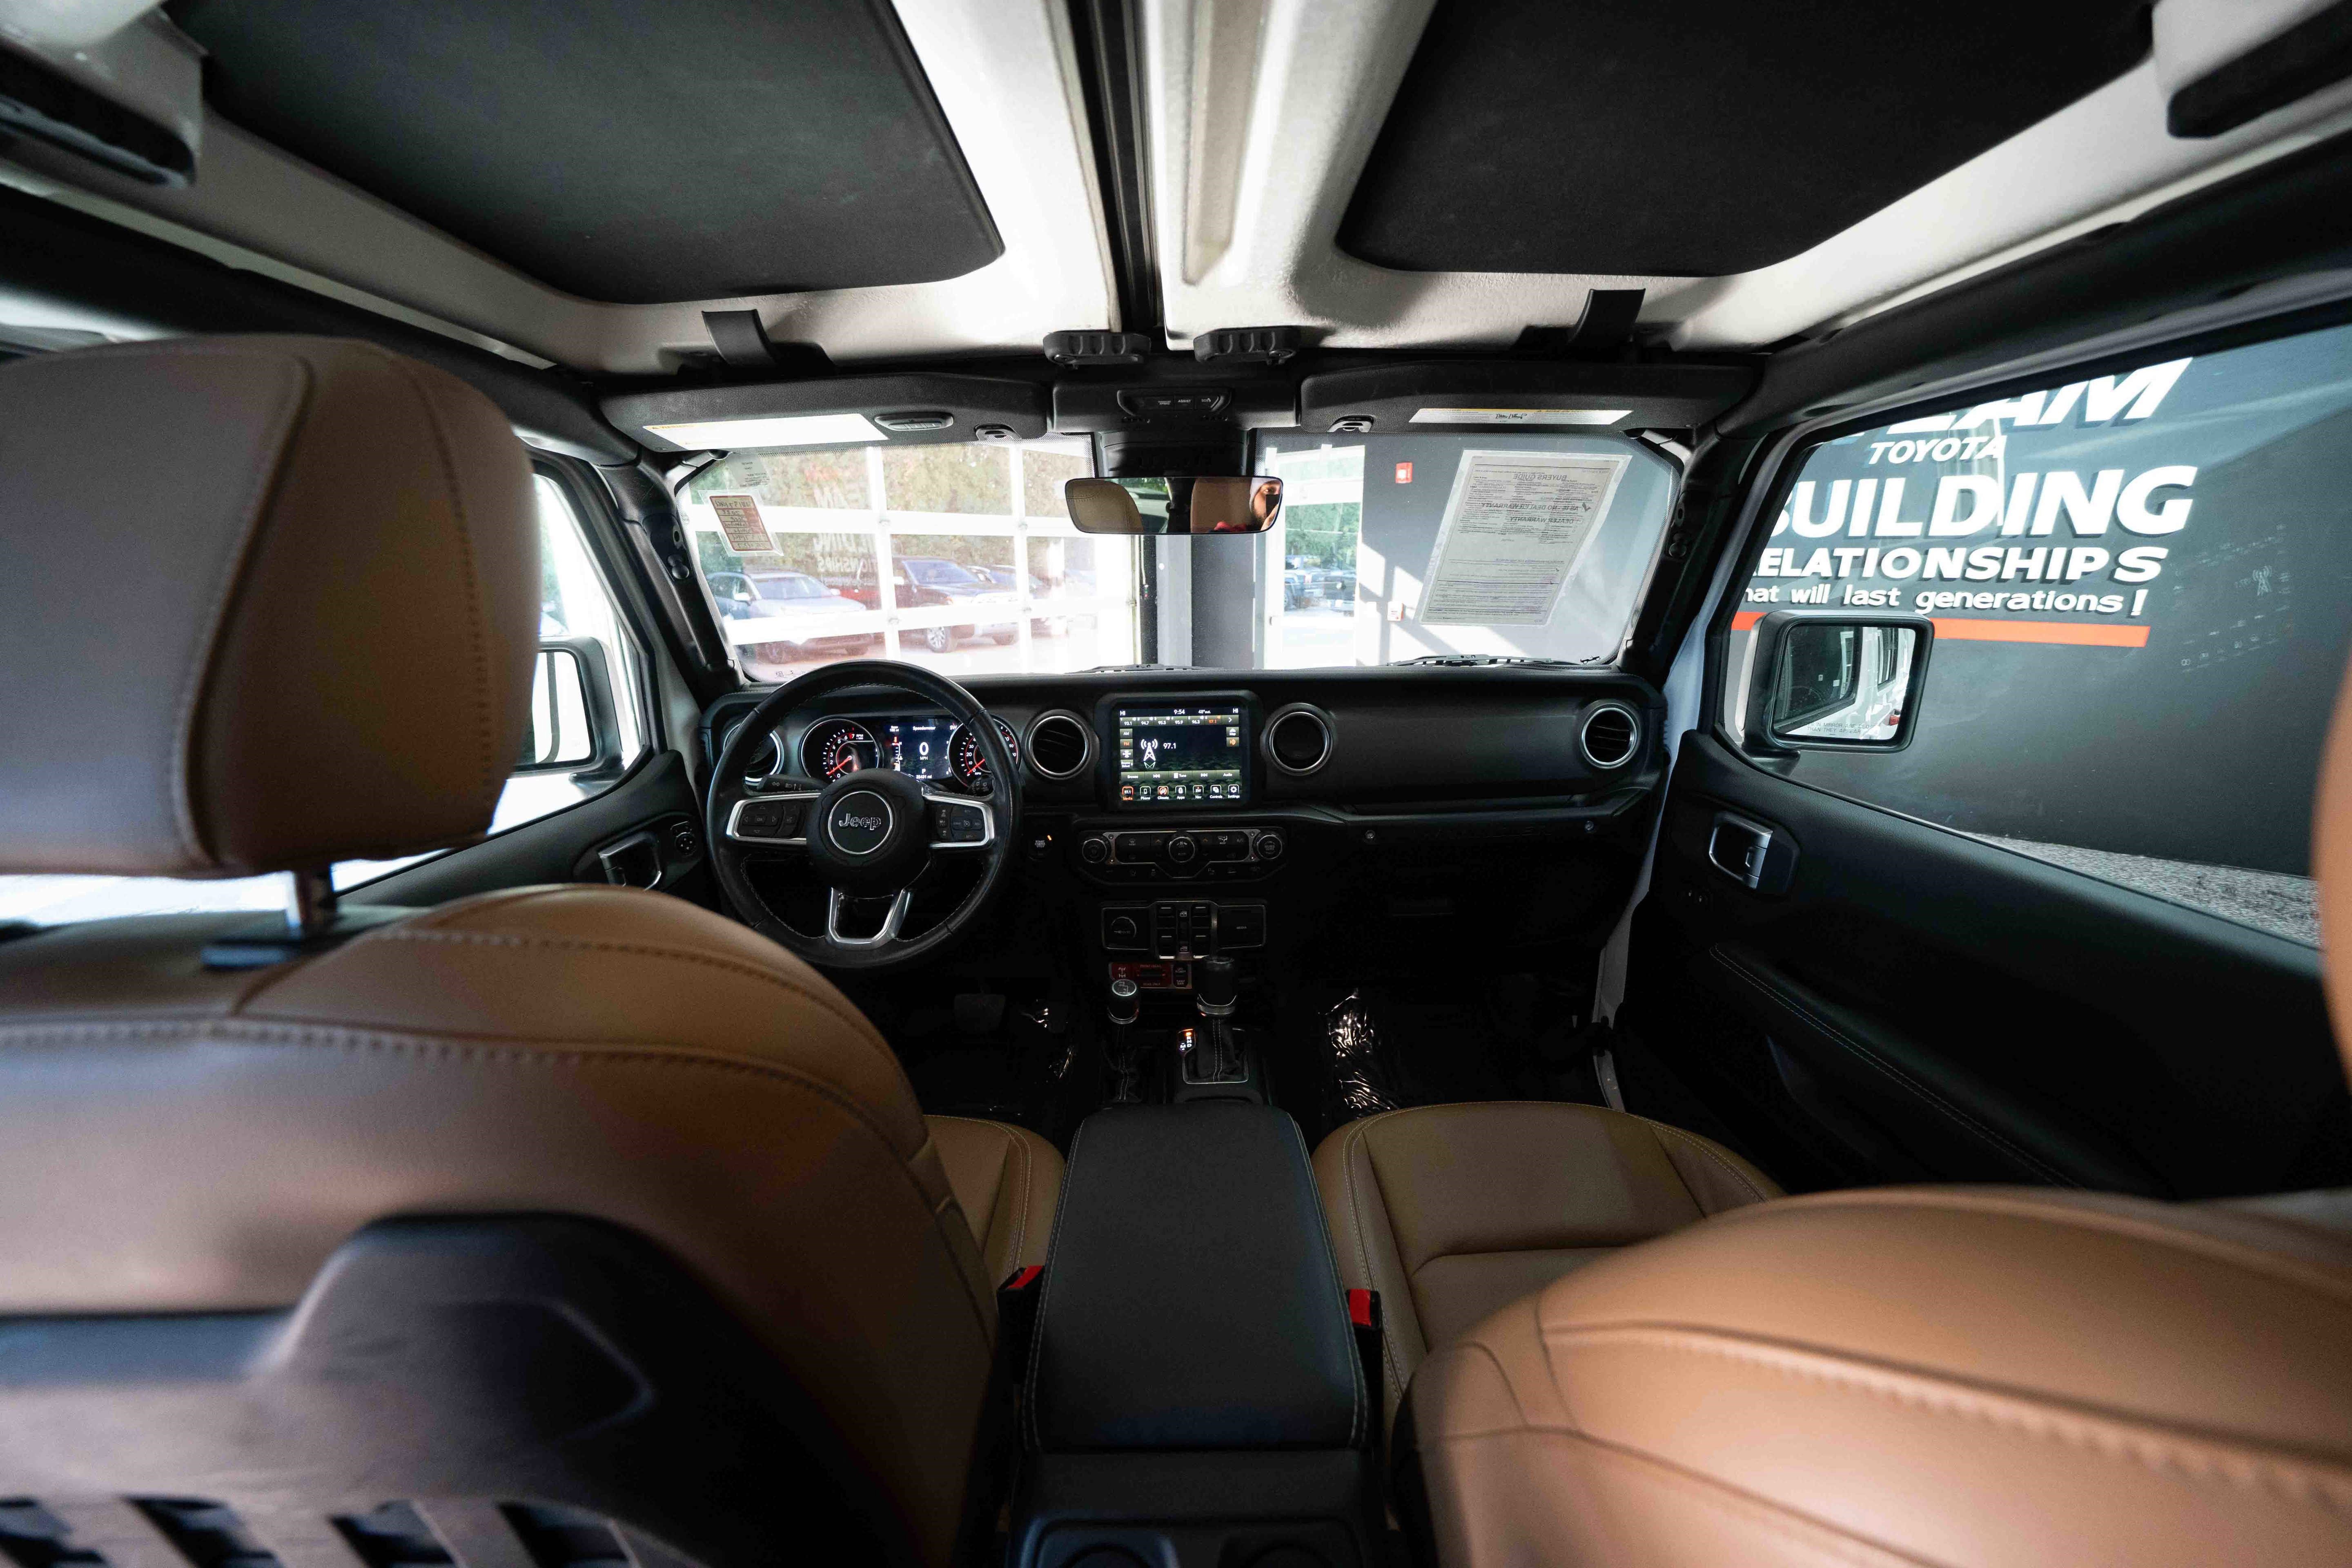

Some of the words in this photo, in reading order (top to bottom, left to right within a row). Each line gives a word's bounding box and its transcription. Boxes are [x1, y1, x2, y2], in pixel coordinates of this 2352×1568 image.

[1853, 357, 2193, 436] AM
[1868, 435, 2007, 465] TOYOTA
[1750, 547, 2168, 583] ELATIONSHIPS
[1791, 584, 1830, 604] will
[1843, 584, 1900, 606] last
[919, 742, 929, 756] 0
[839, 813, 882, 831] Jeep
